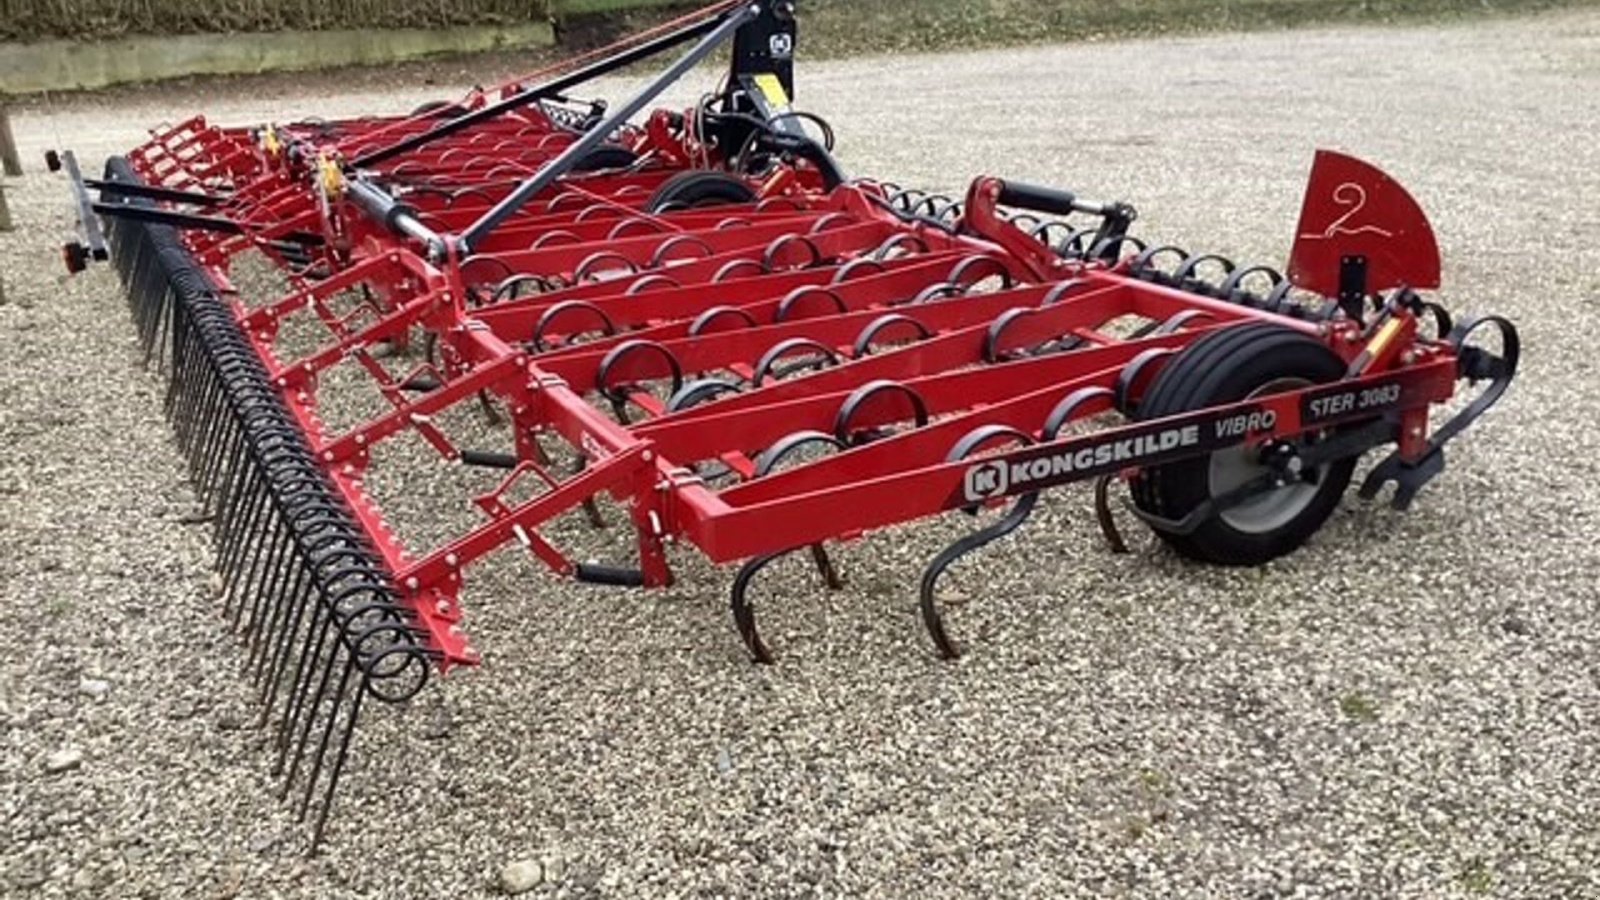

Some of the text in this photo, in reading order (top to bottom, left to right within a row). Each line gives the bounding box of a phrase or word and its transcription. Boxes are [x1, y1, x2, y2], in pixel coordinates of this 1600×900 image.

[1325, 182, 1392, 239] 2
[1011, 425, 1200, 484] KONGSKILDE
[1215, 410, 1277, 438] VIBRO
